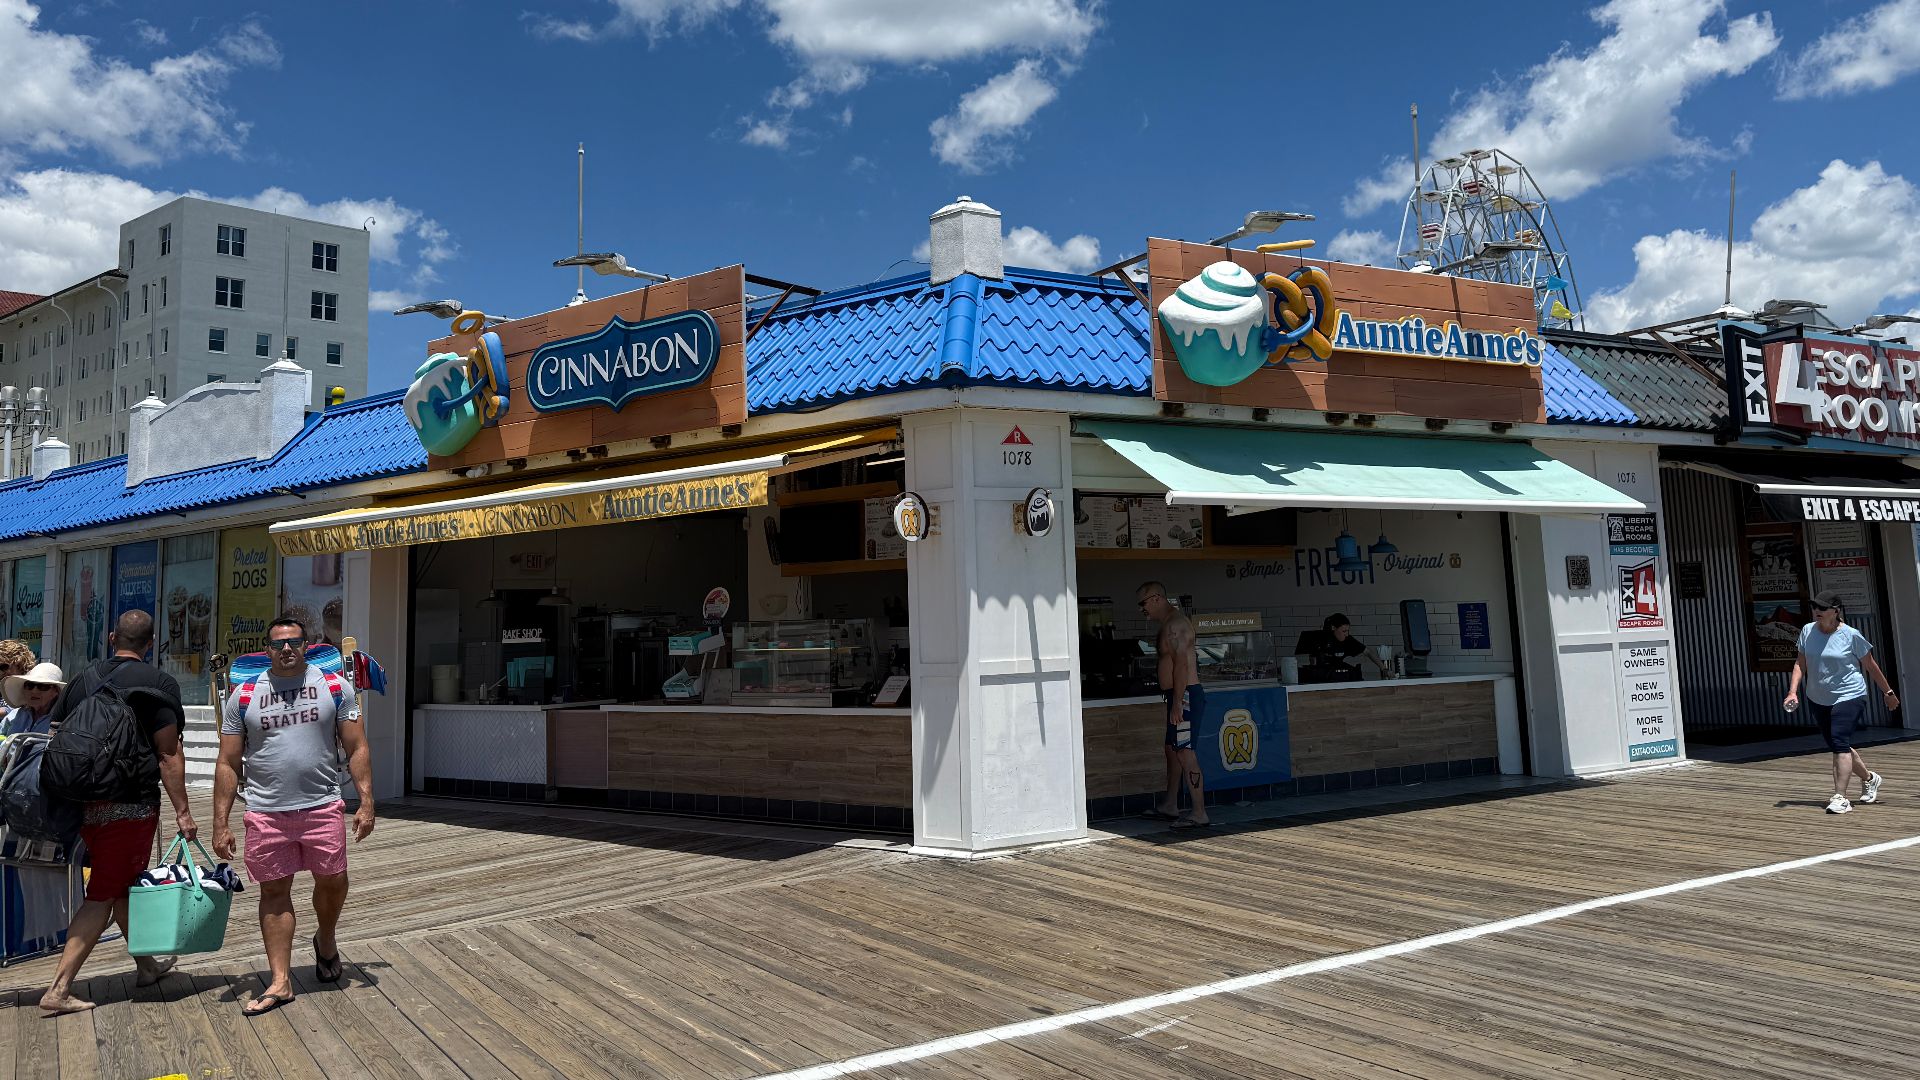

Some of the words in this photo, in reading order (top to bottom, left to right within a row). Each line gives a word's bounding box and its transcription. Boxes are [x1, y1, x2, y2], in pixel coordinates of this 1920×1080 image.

[537, 328, 699, 397] CINNABON
[1811, 347, 1920, 393] ESCAP
[1741, 339, 1770, 422] EXIT
[1775, 342, 1824, 423] 4
[1014, 431, 1021, 443] R
[1003, 451, 1031, 466] 1078
[1801, 497, 1840, 520] EXIT
[1844, 499, 1857, 520] 4
[233, 545, 269, 567] Pretzel
[527, 555, 543, 568] EXIT
[1240, 560, 1285, 579] Simple
[1384, 553, 1445, 574] Original
[232, 568, 267, 589] DOGS
[17, 585, 43, 616] Love
[1622, 570, 1635, 613] EXIT
[1638, 570, 1655, 612] 4
[231, 614, 265, 635] Churro
[502, 628, 521, 639] BAKE
[522, 627, 543, 639] SHOP
[1624, 658, 1665, 668] OWNERS
[1630, 648, 1657, 657] SAME
[1636, 681, 1658, 690] NEW
[260, 686, 317, 709] UNITED
[1631, 692, 1665, 702] ROOMS
[261, 707, 319, 730] STATES
[1636, 715, 1663, 725] MORE
[1642, 727, 1661, 735] FUN
